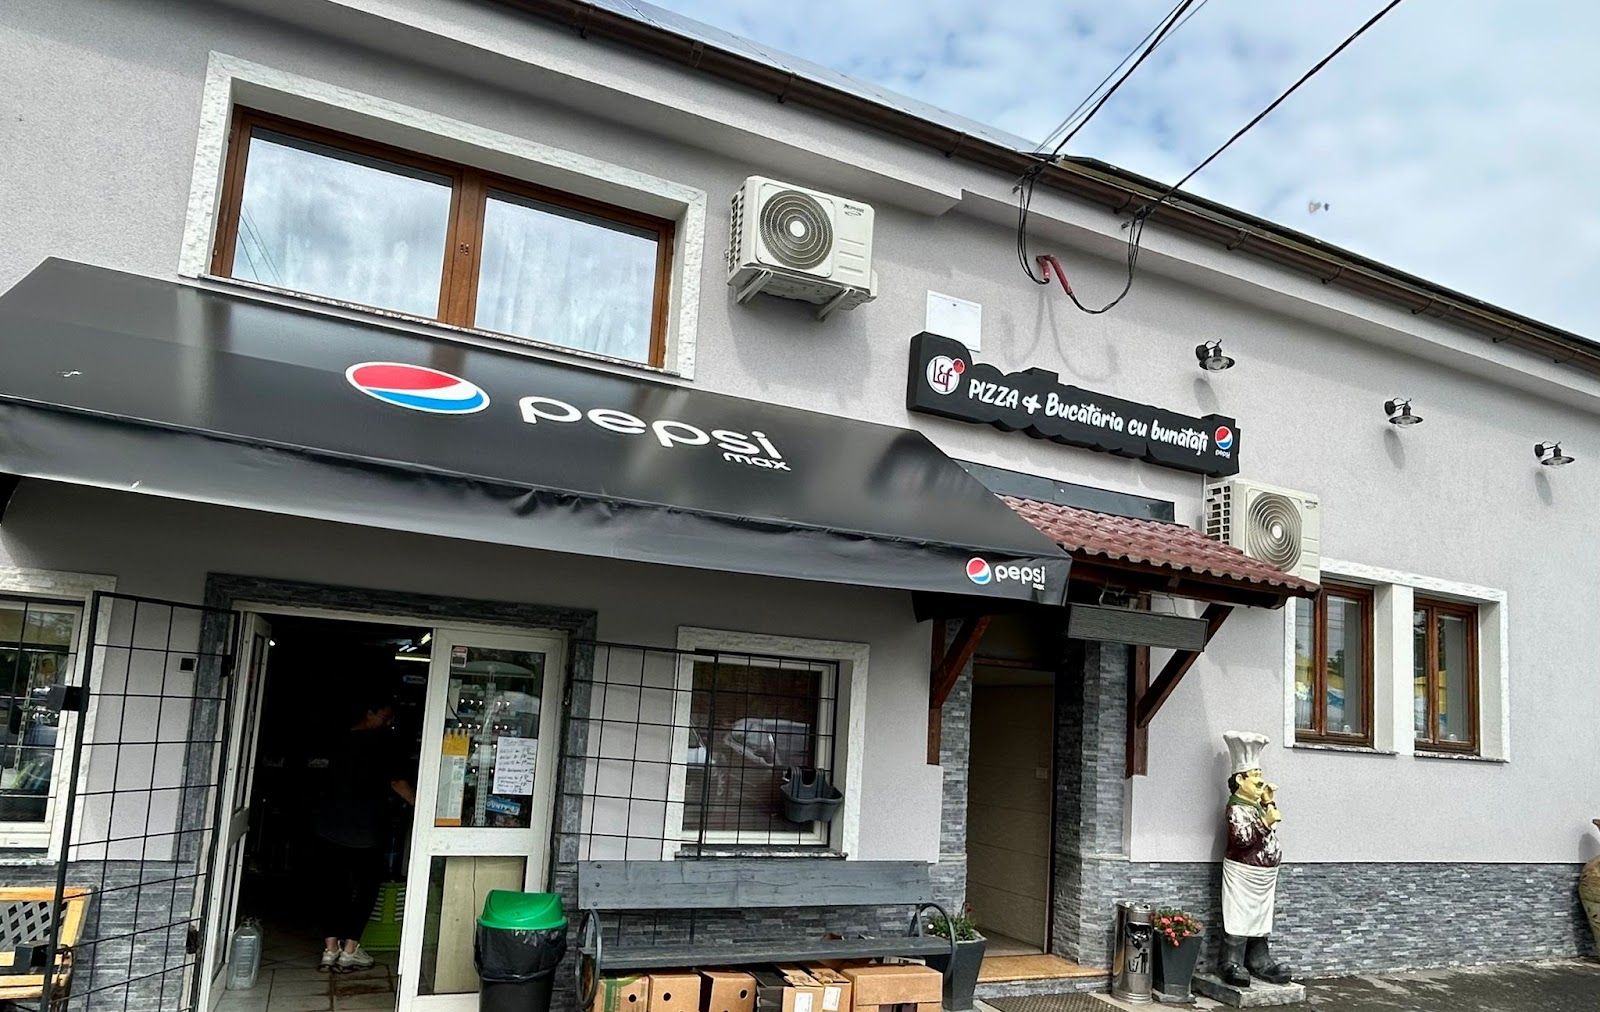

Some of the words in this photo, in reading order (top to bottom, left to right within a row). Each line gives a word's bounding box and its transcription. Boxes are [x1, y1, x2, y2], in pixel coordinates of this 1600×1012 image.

[519, 395, 782, 460] pepsi
[968, 378, 1019, 410] PIZZA
[1045, 392, 1124, 432] Bucătăria
[1127, 418, 1148, 438] cu
[722, 451, 792, 472] max
[995, 565, 1045, 584] pepsi
